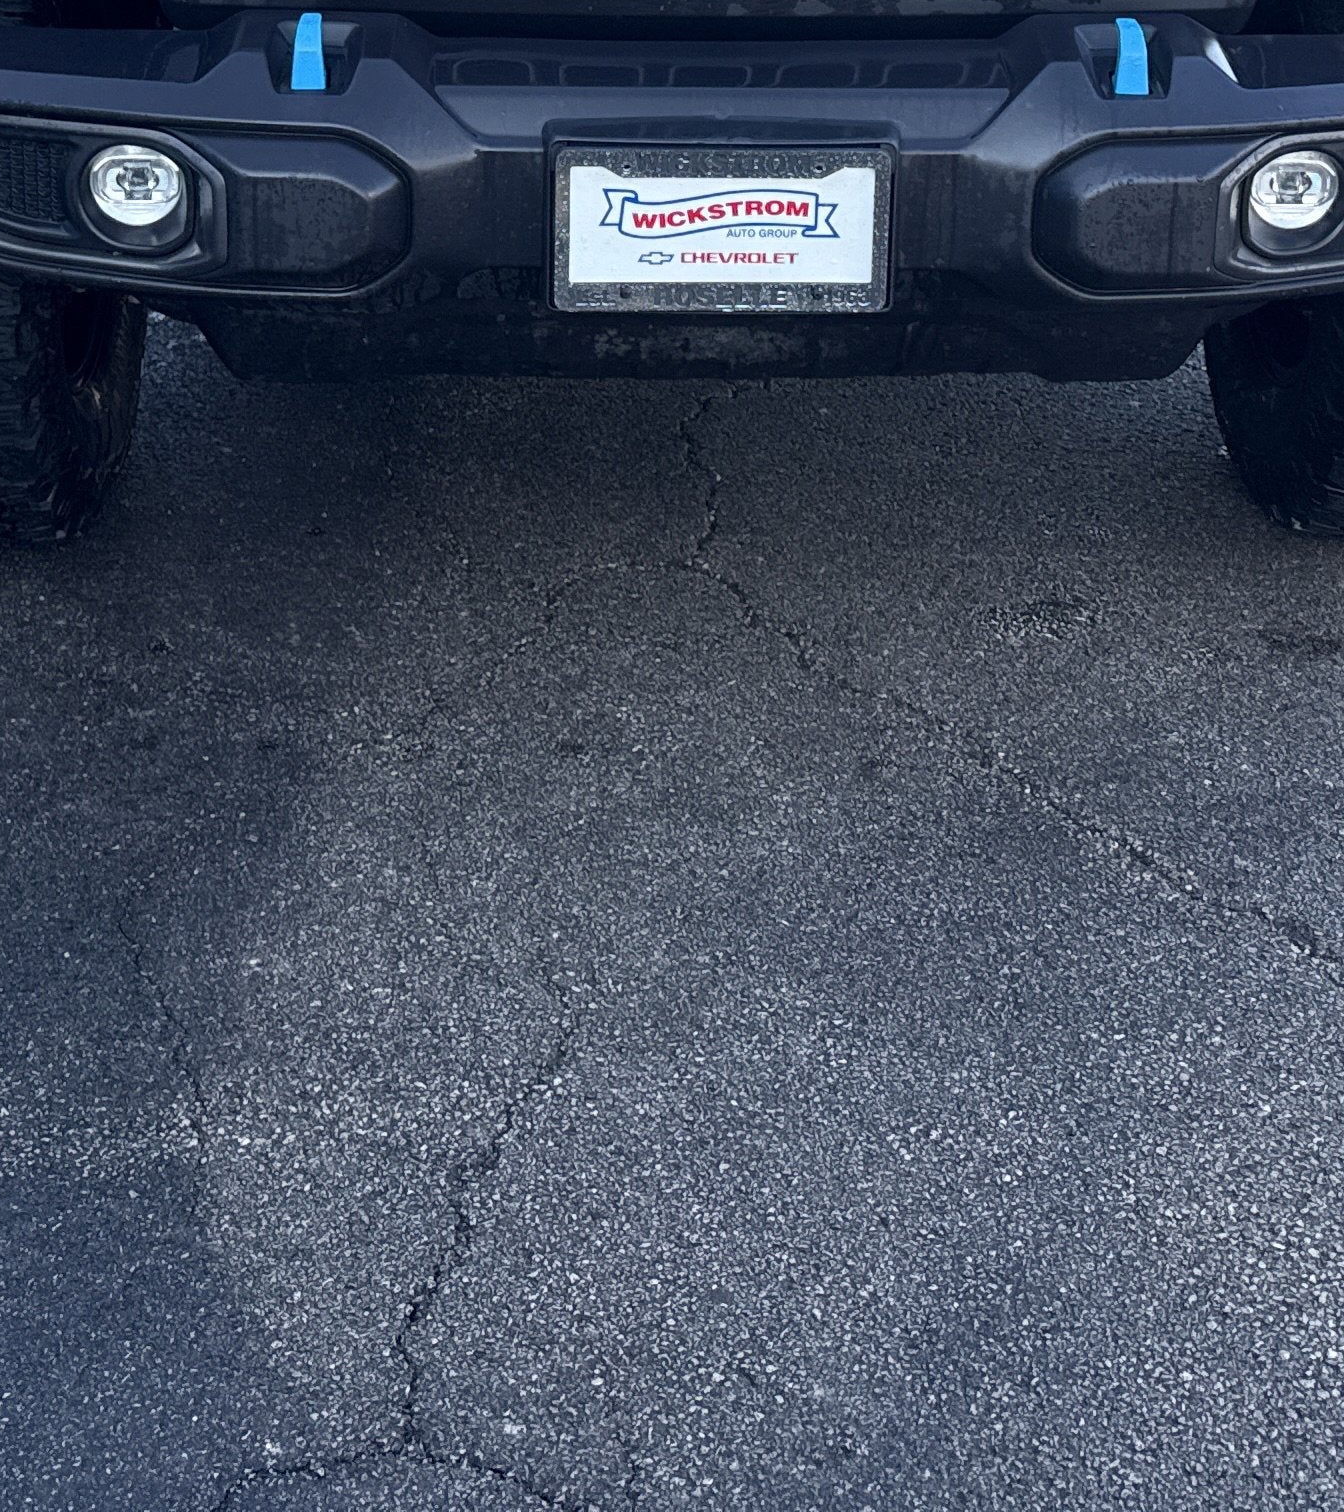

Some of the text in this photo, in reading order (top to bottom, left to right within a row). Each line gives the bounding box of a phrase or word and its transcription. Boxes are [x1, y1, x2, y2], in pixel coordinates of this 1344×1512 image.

[632, 200, 810, 229] WICKSTROM
[726, 228, 798, 239] AUTO GROUP
[680, 252, 800, 265] CHEVROLET
